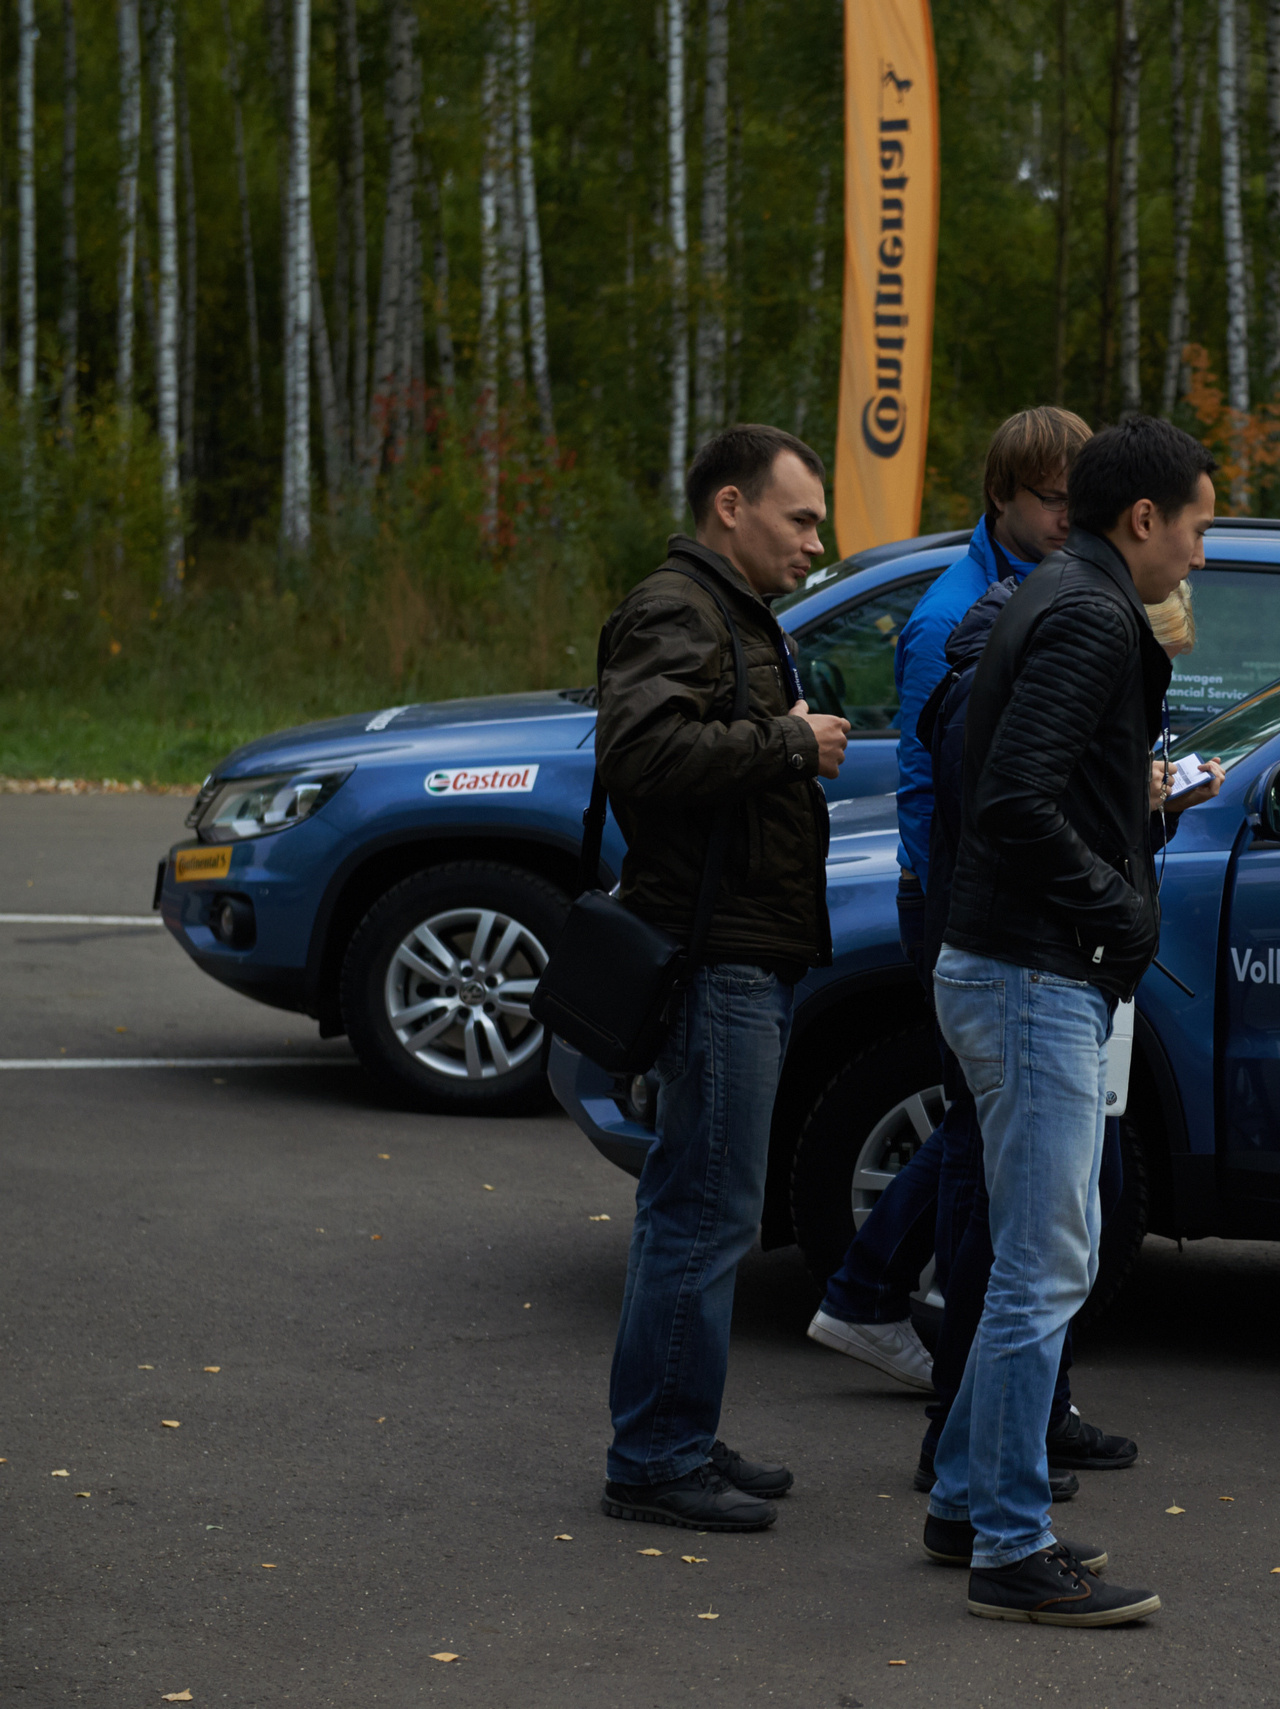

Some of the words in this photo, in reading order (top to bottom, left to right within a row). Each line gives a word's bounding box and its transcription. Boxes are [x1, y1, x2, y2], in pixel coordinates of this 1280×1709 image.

[1171, 671, 1223, 686] kswagen
[1207, 687, 1249, 701] Service
[452, 768, 530, 791] Castrol
